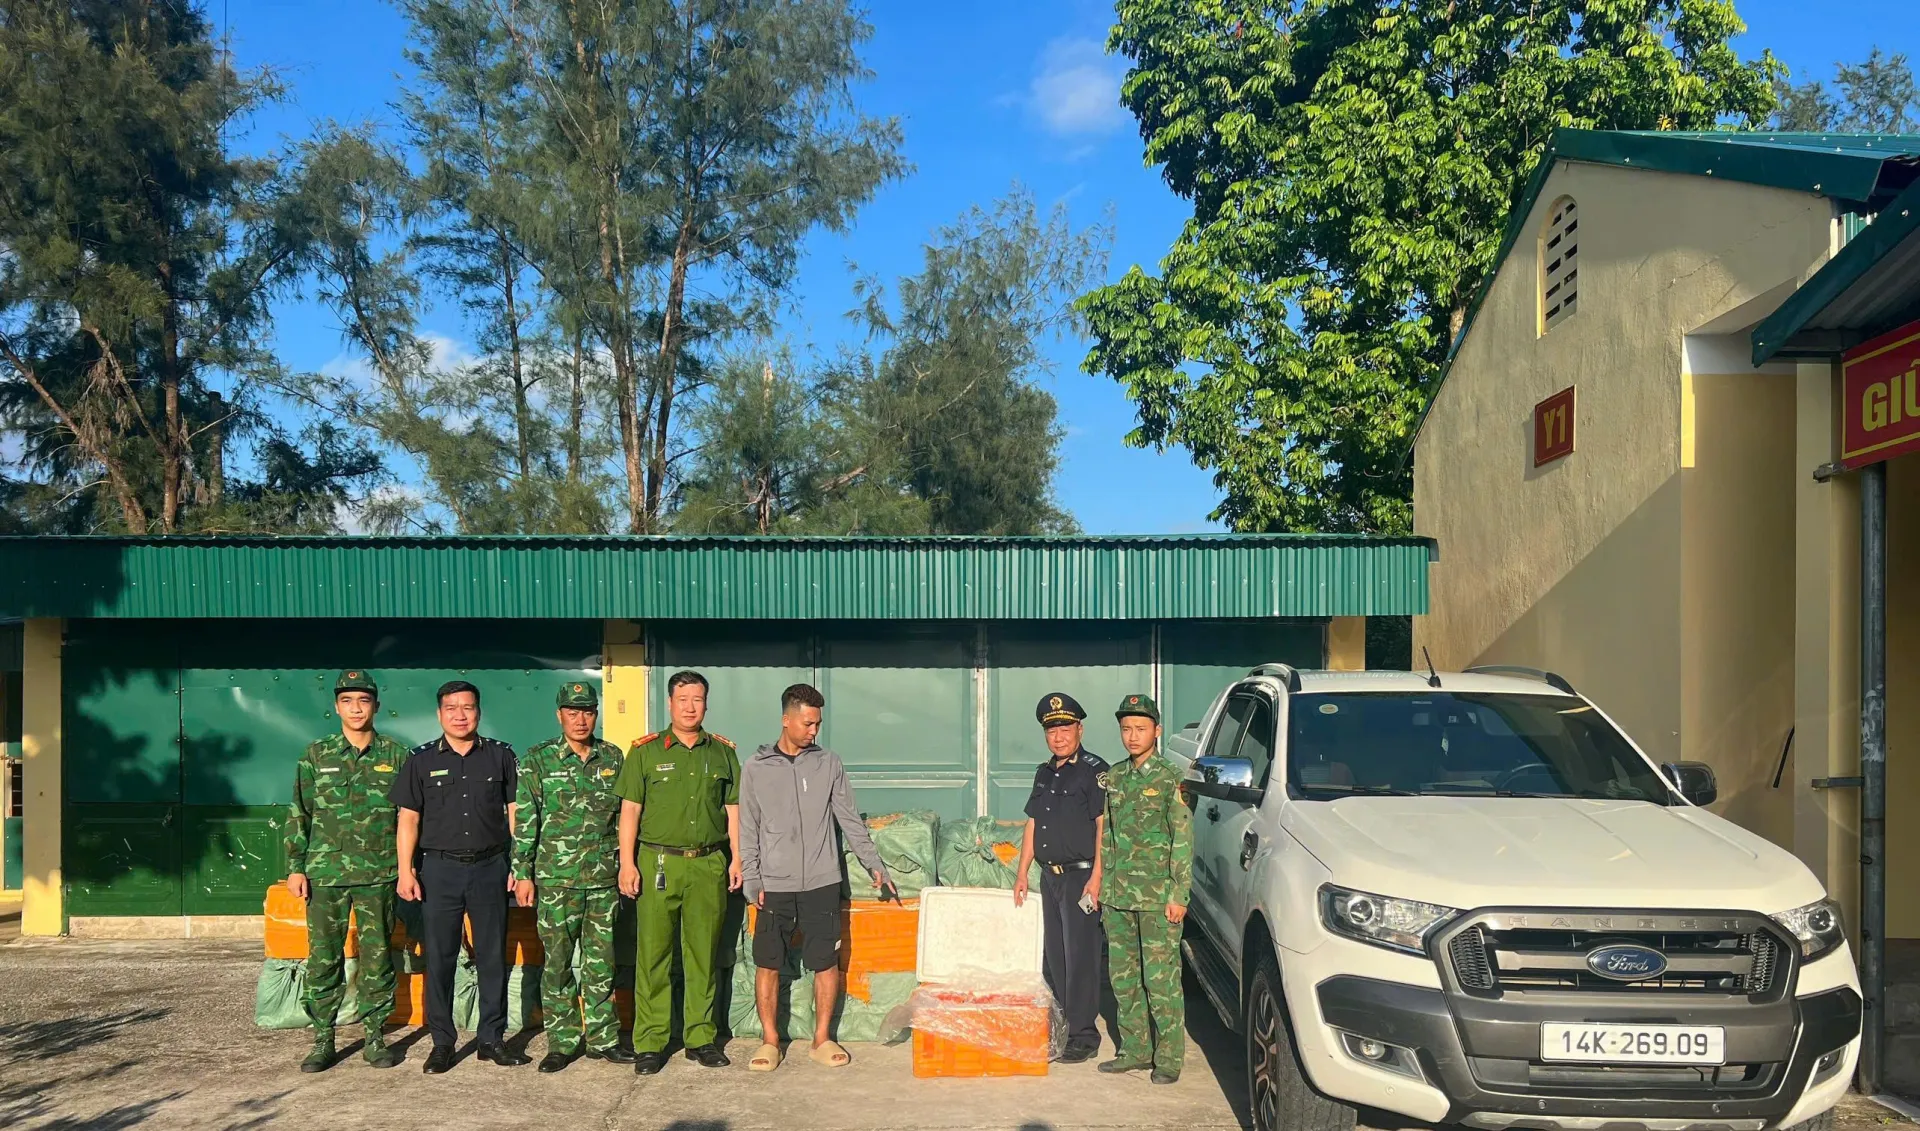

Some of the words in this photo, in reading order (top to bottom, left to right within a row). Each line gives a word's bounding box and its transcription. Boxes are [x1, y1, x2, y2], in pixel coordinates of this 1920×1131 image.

[1543, 404, 1565, 449] Y1
[1607, 953, 1649, 971] Ford
[1562, 1030, 1708, 1056] 14K-269.09
